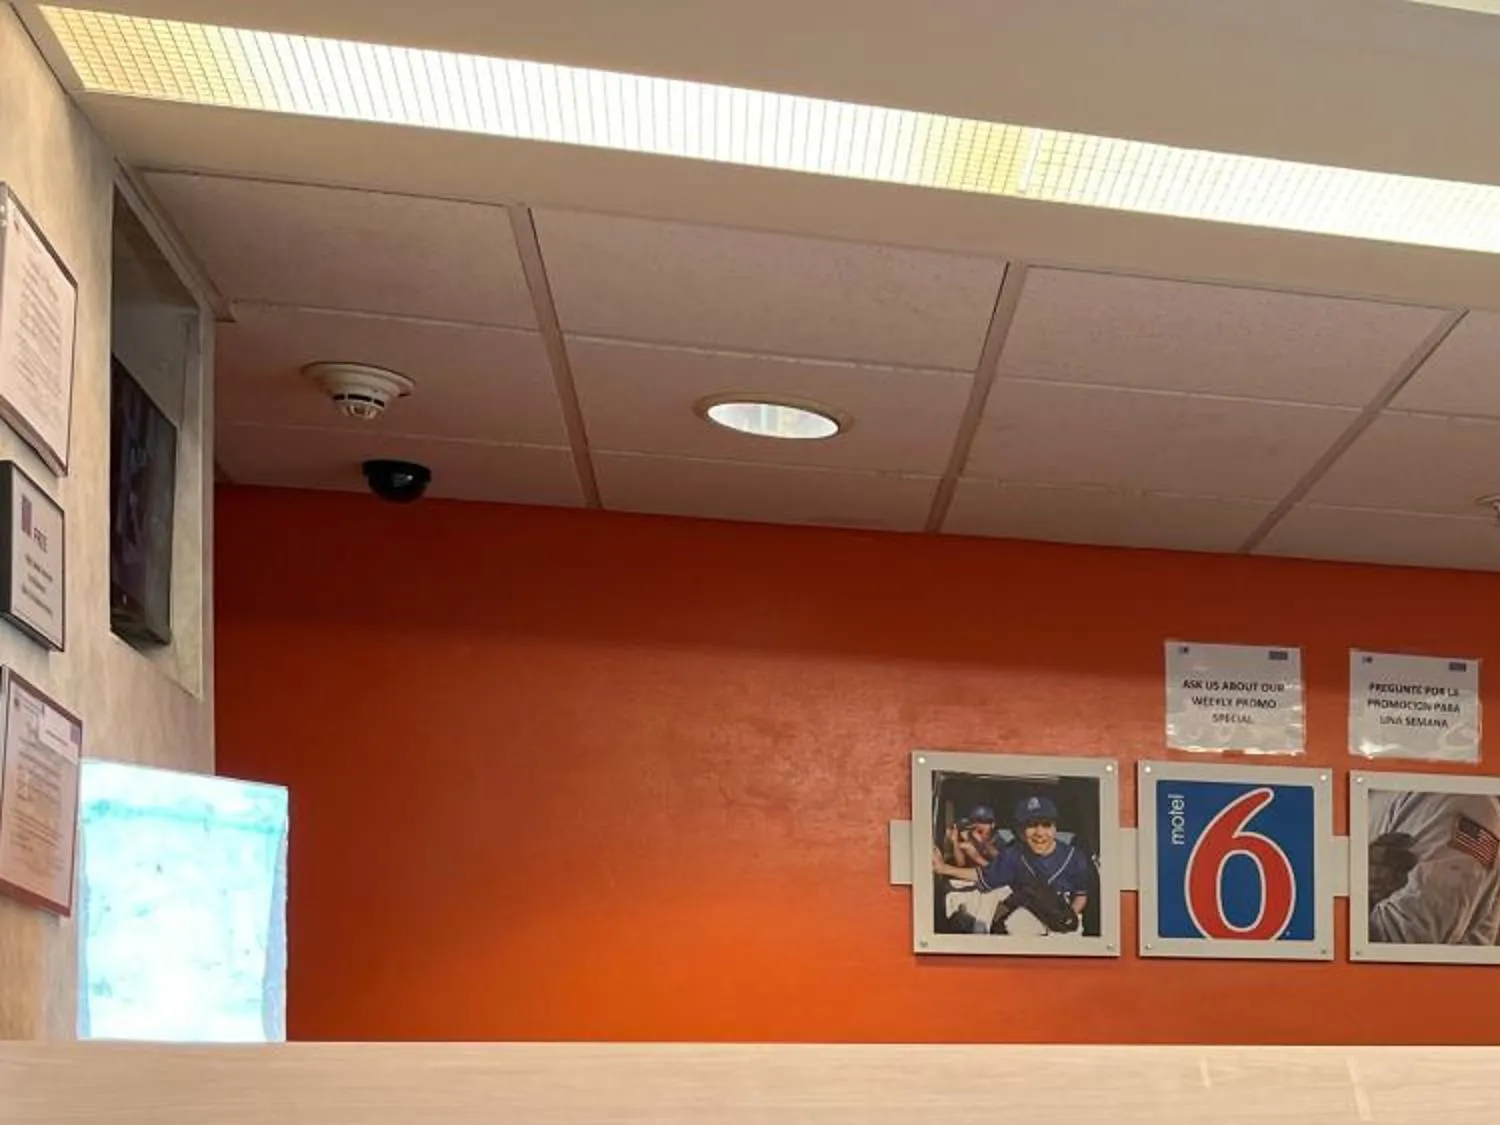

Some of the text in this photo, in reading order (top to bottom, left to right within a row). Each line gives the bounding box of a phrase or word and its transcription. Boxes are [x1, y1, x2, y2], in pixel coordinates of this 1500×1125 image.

[1183, 679, 1285, 693] ASK US ABOUT OUR
[1369, 682, 1422, 695] PREGUNTE
[1425, 686, 1445, 696] POR
[1192, 696, 1277, 709] WEEKLY PROMO
[1168, 793, 1185, 846] motel
[1184, 787, 1296, 941] 6
